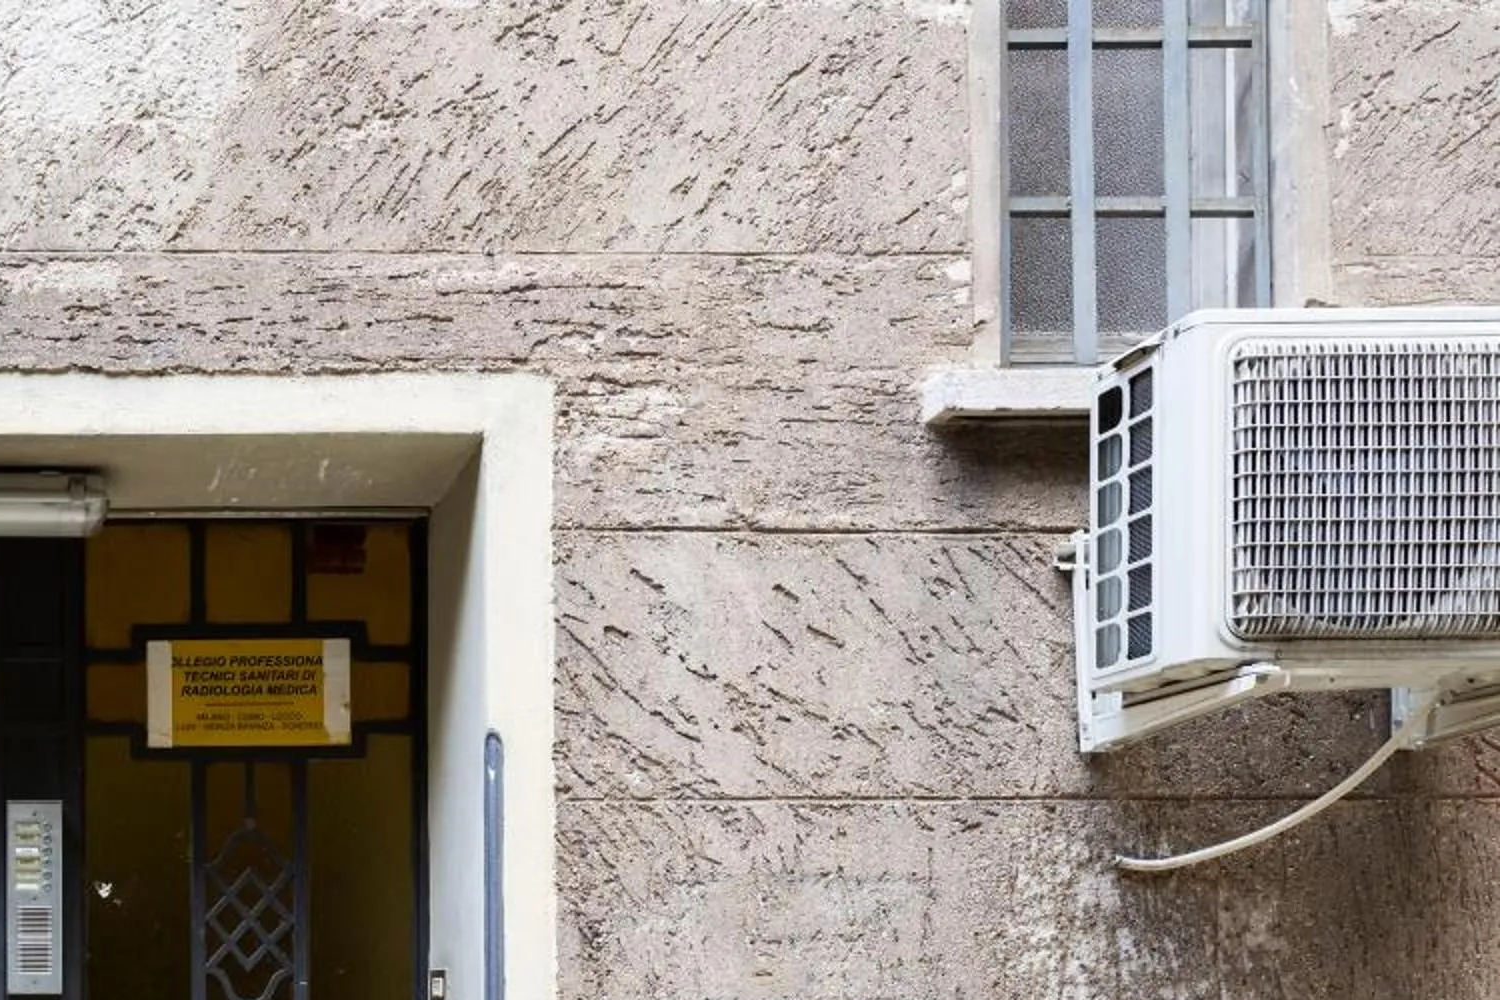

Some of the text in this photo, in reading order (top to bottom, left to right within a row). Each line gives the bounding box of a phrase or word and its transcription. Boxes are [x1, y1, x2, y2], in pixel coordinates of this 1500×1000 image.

[184, 669, 316, 682] TECNICI SANITARI DI
[181, 684, 317, 696] RADIOLOGIA MEDICA
